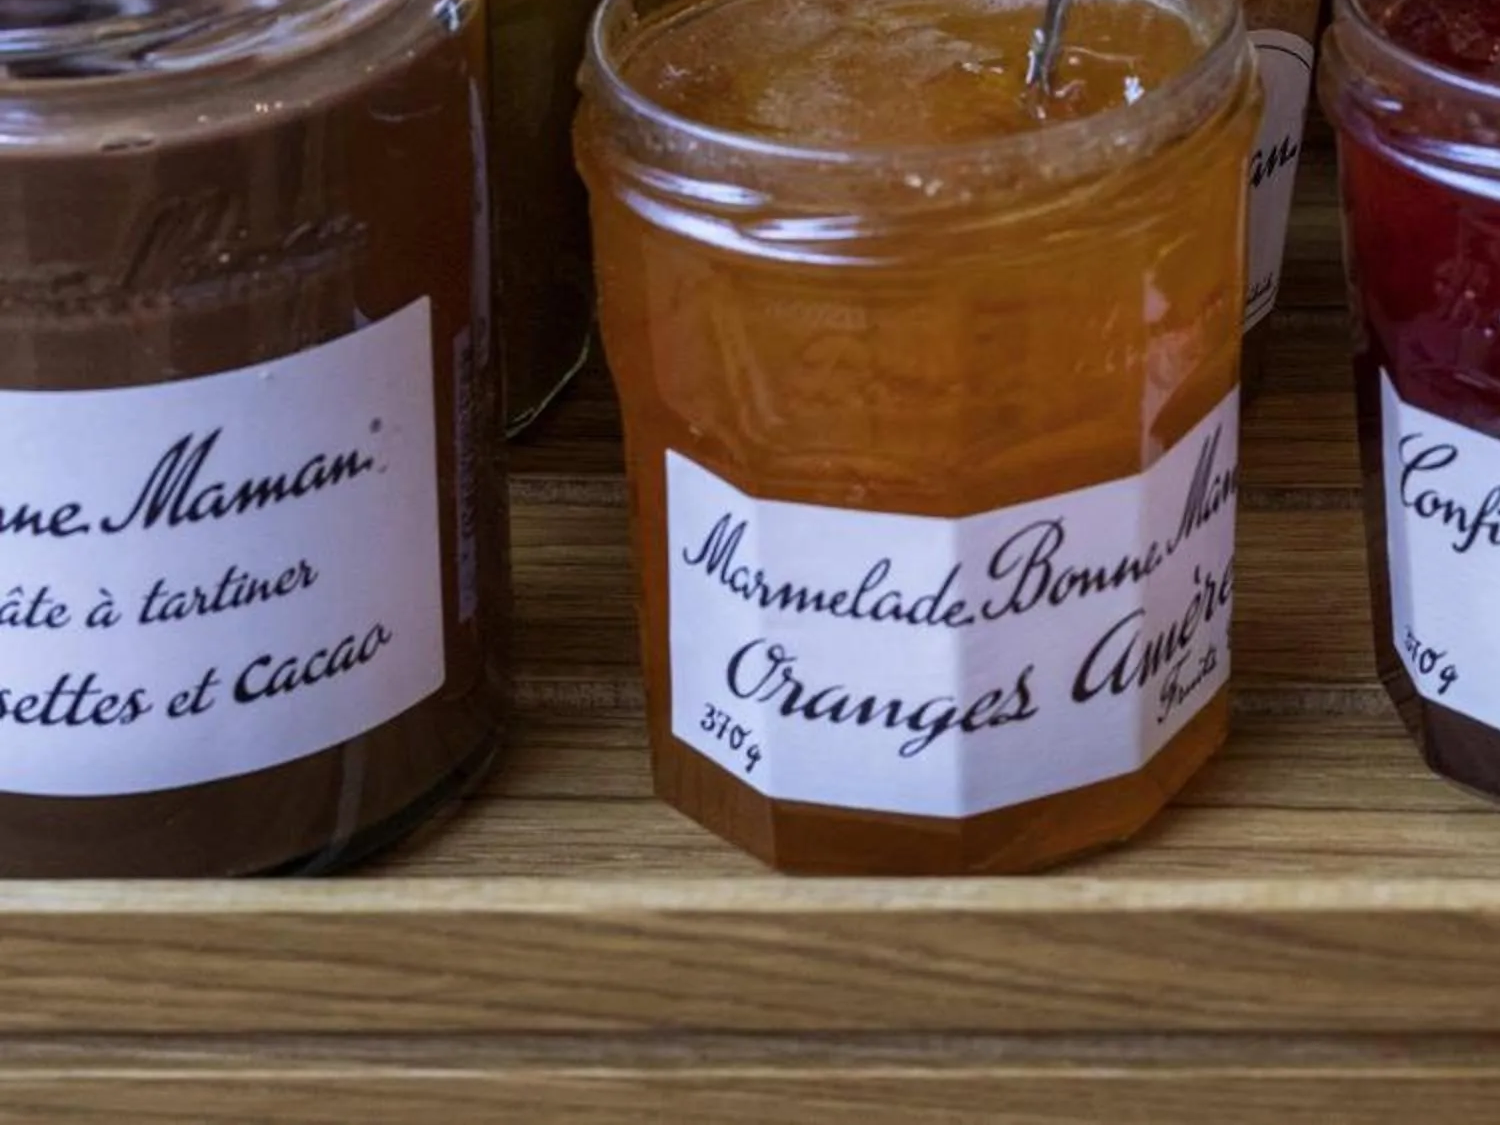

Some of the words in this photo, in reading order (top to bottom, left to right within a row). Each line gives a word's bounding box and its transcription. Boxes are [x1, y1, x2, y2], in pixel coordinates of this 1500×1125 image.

[102, 426, 374, 534] Maman
[0, 585, 72, 628] âte
[86, 588, 121, 629] à
[138, 558, 319, 626] tartiner
[682, 511, 976, 628] Marmelade
[980, 514, 1163, 621] Bonne
[0, 671, 154, 727] settes
[167, 667, 224, 718] et
[233, 621, 391, 705] Cacao
[725, 636, 1041, 758] Oranges
